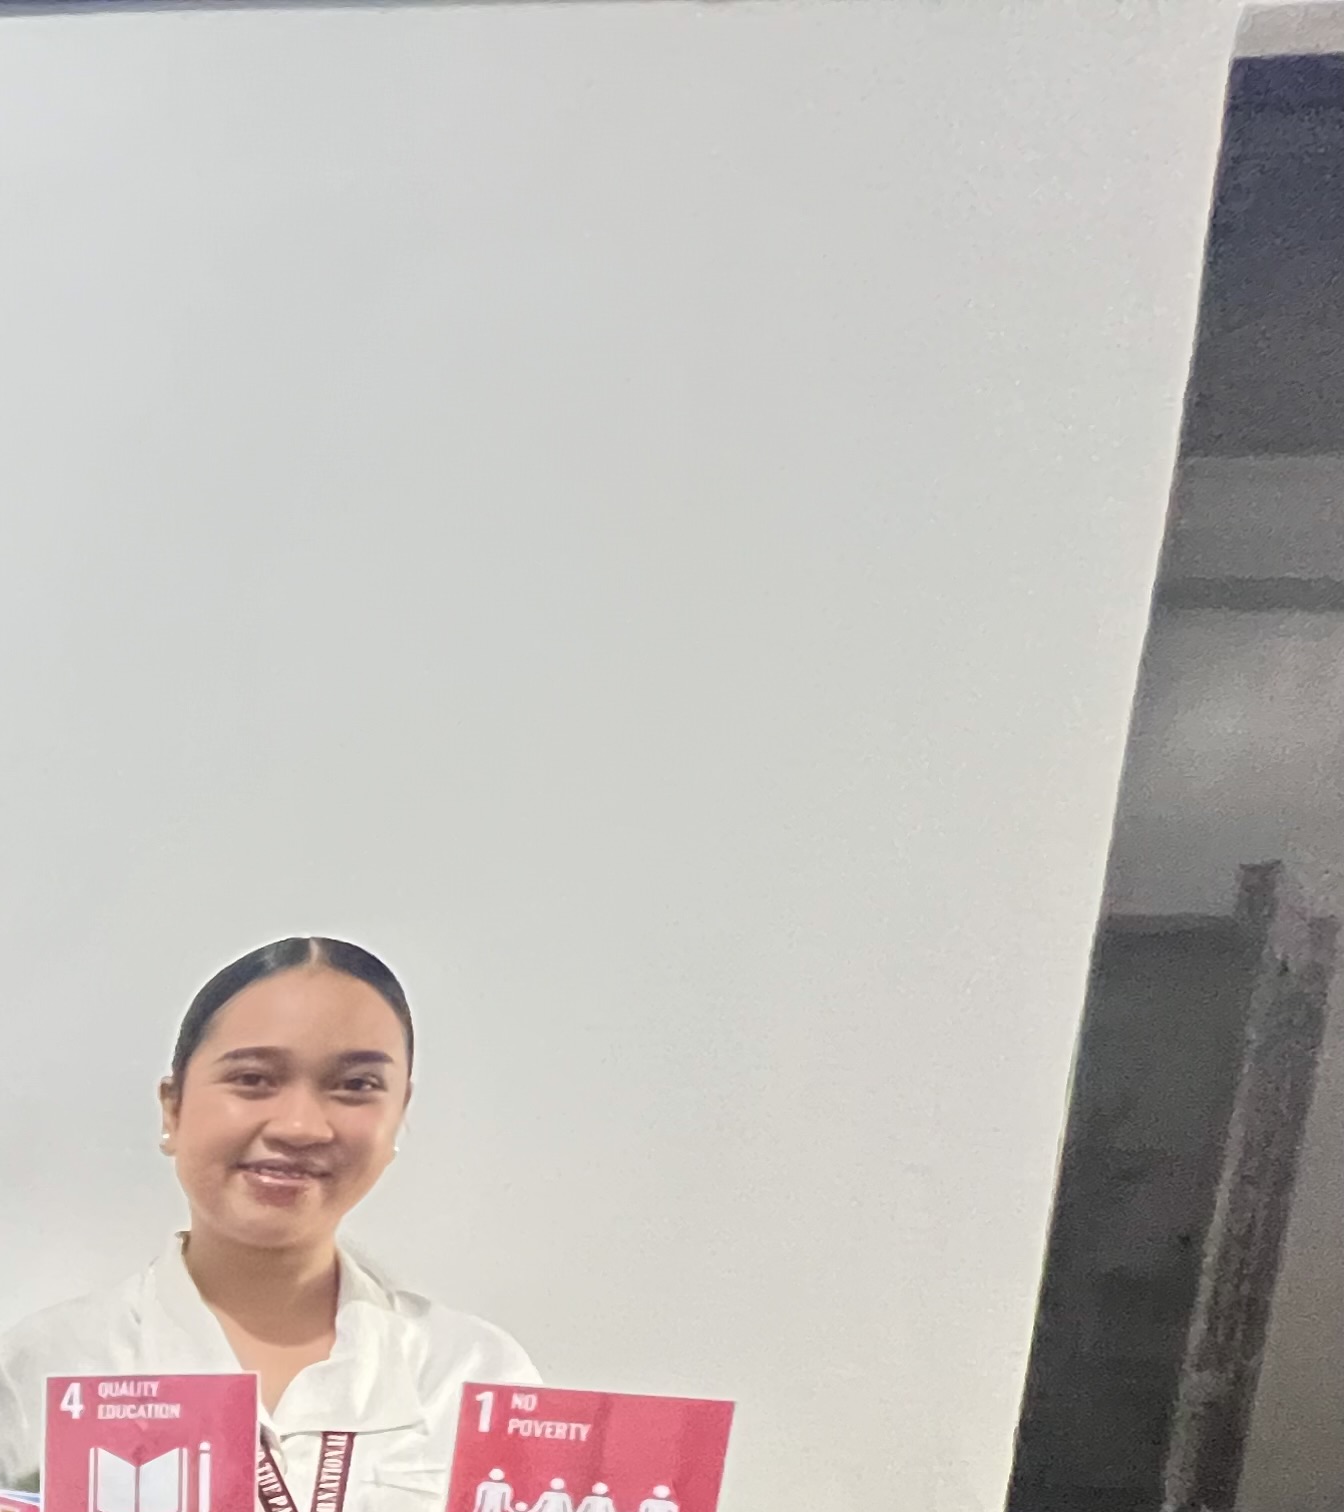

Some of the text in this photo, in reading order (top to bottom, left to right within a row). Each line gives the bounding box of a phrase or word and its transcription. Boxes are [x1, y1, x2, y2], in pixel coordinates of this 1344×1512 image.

[98, 1381, 160, 1398] QUALITY
[60, 1382, 85, 1420] 4
[98, 1403, 181, 1420] EDUCATION
[475, 1391, 495, 1433] 1
[511, 1392, 537, 1412] NO
[507, 1418, 592, 1442] POVERTY
